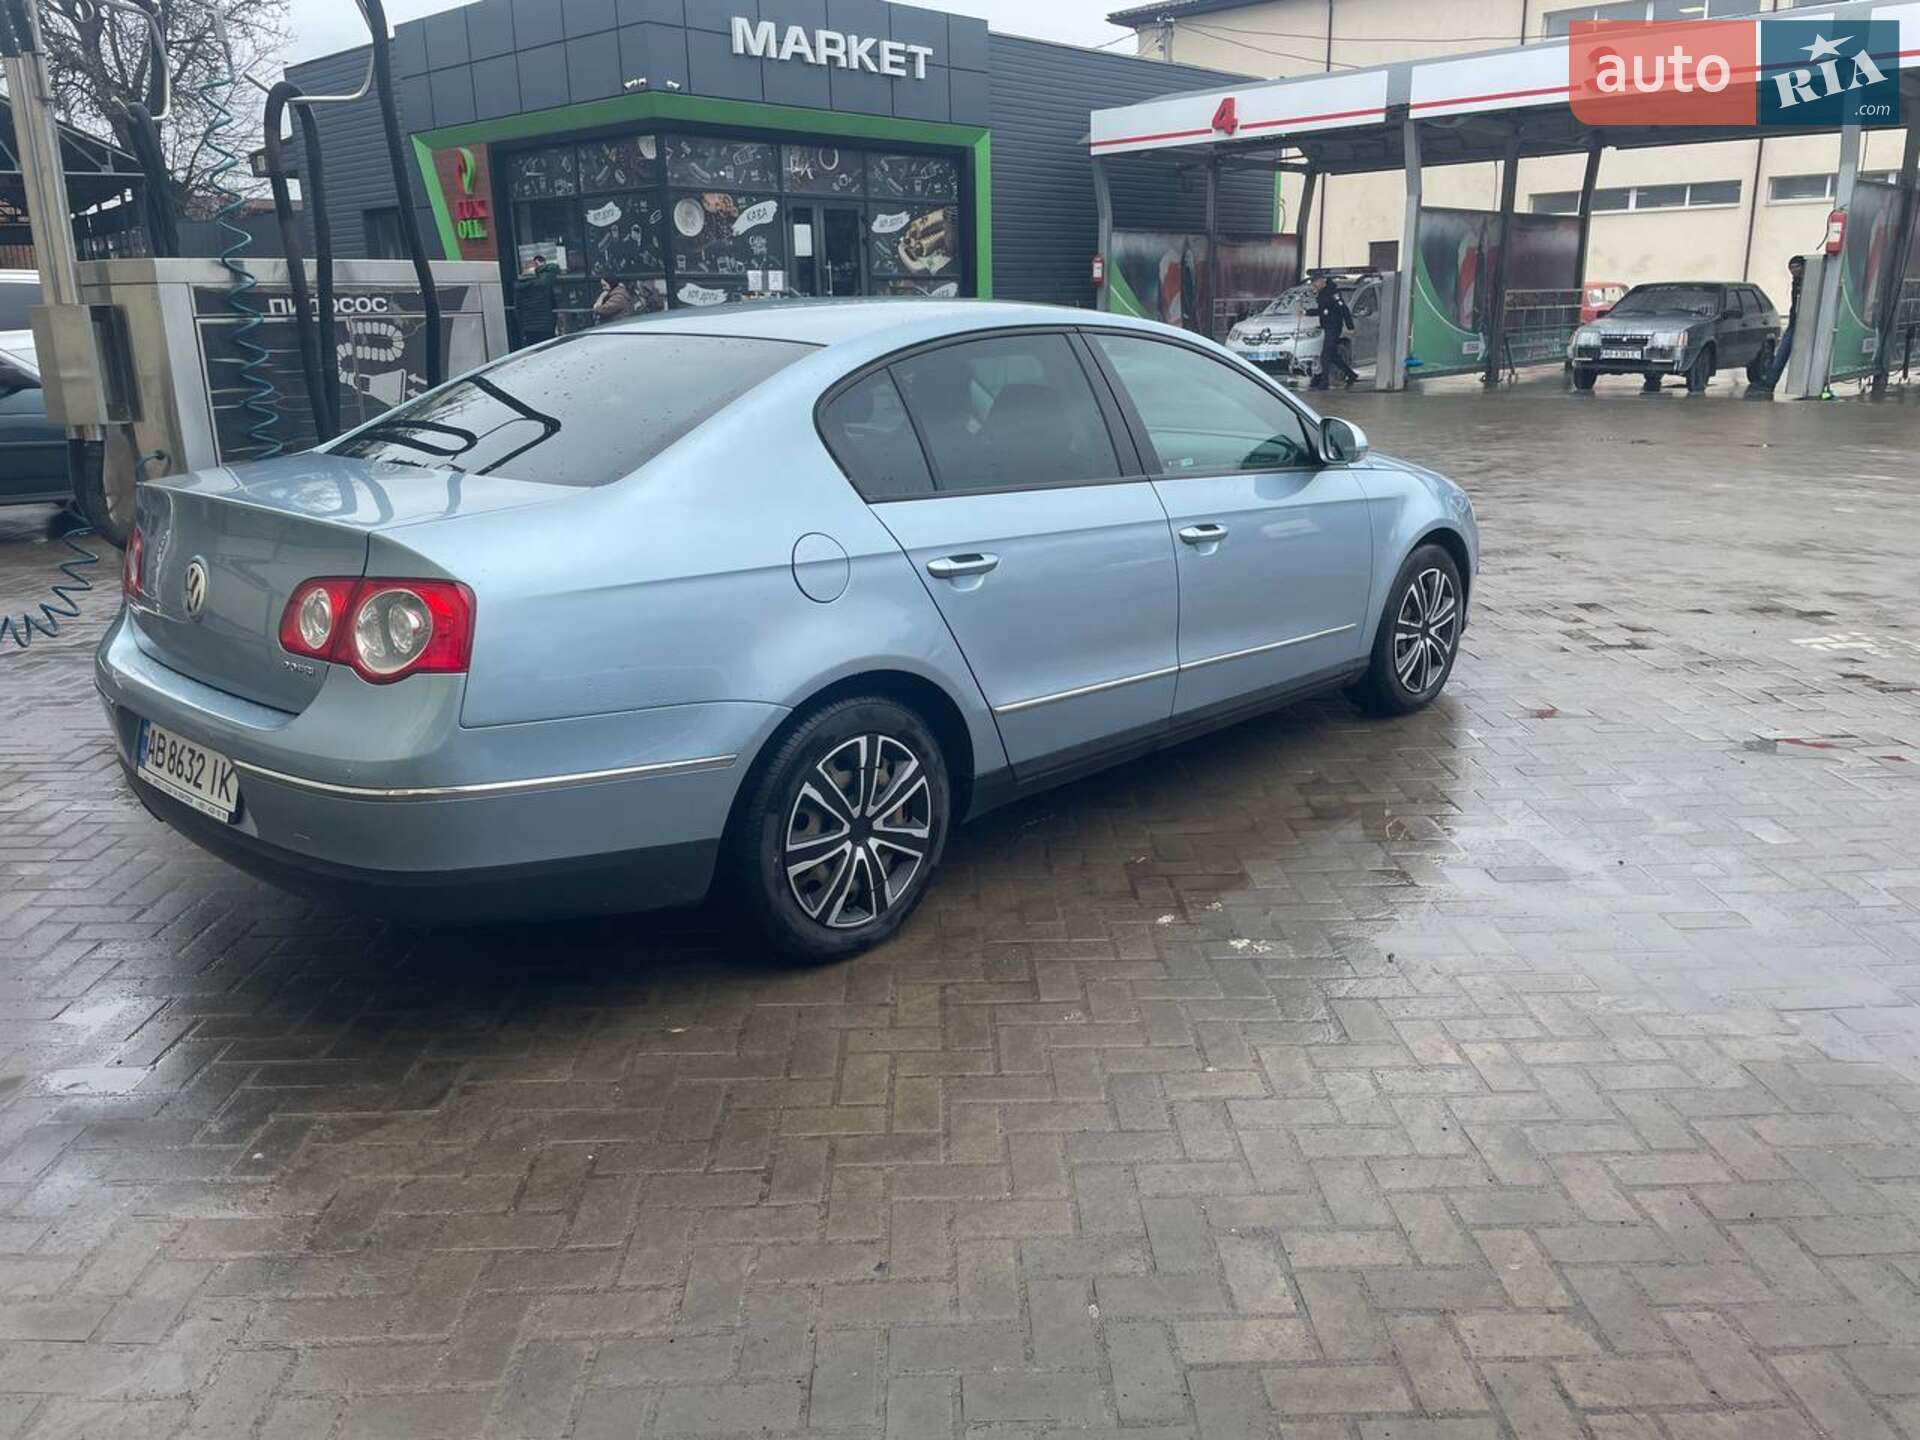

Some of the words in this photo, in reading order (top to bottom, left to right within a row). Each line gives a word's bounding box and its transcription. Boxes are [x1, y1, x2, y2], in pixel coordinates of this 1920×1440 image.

[731, 17, 934, 80] MARKET
[1211, 96, 1238, 135] 4
[457, 219, 487, 239] OIL
[148, 729, 166, 769] AB
[167, 740, 206, 791] 8632
[210, 758, 235, 803] IK
